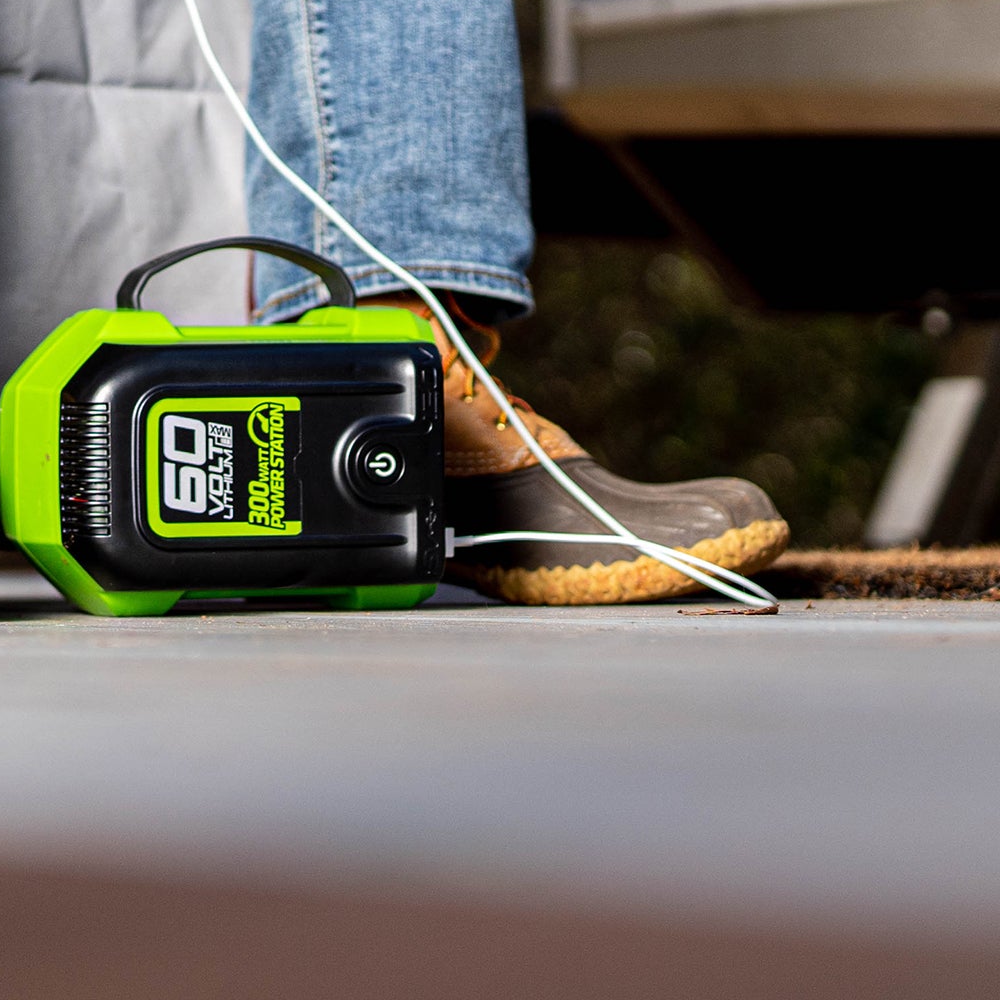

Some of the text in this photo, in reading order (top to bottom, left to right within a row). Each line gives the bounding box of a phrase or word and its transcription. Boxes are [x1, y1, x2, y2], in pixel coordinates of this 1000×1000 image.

[163, 415, 207, 514] 60
[209, 423, 232, 437] MAX
[269, 403, 285, 528] POWER STATION
[208, 437, 225, 516] VOLT
[223, 450, 234, 520] LITHIUM
[248, 448, 270, 526] 300 WATT
